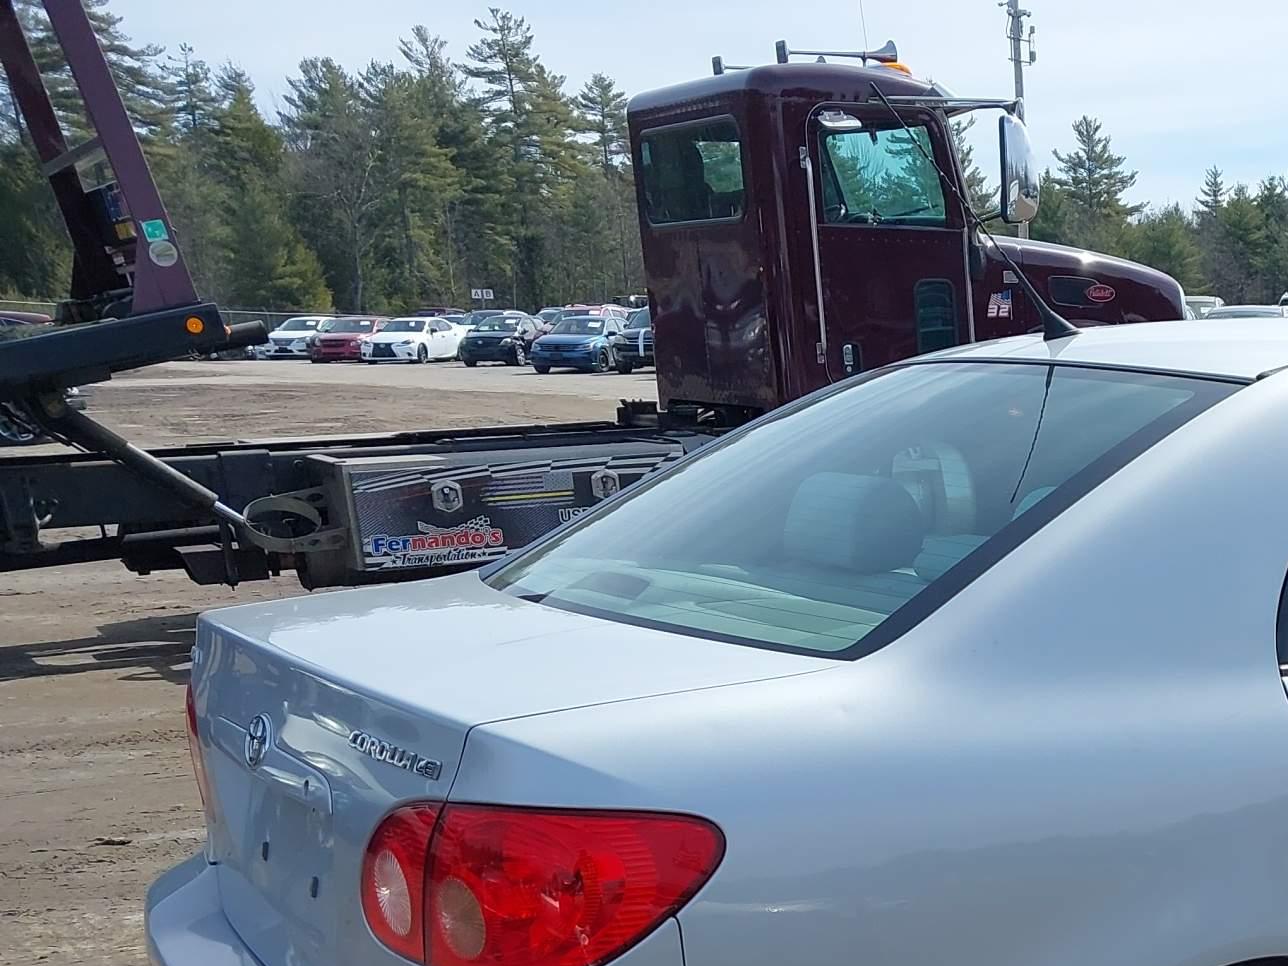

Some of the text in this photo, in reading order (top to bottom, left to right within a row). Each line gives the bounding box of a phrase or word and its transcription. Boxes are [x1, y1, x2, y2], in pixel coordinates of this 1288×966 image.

[986, 304, 1011, 318] 32
[371, 527, 503, 556] Fernando's
[396, 549, 478, 567] Transportation
[348, 729, 418, 770] COROLLA
